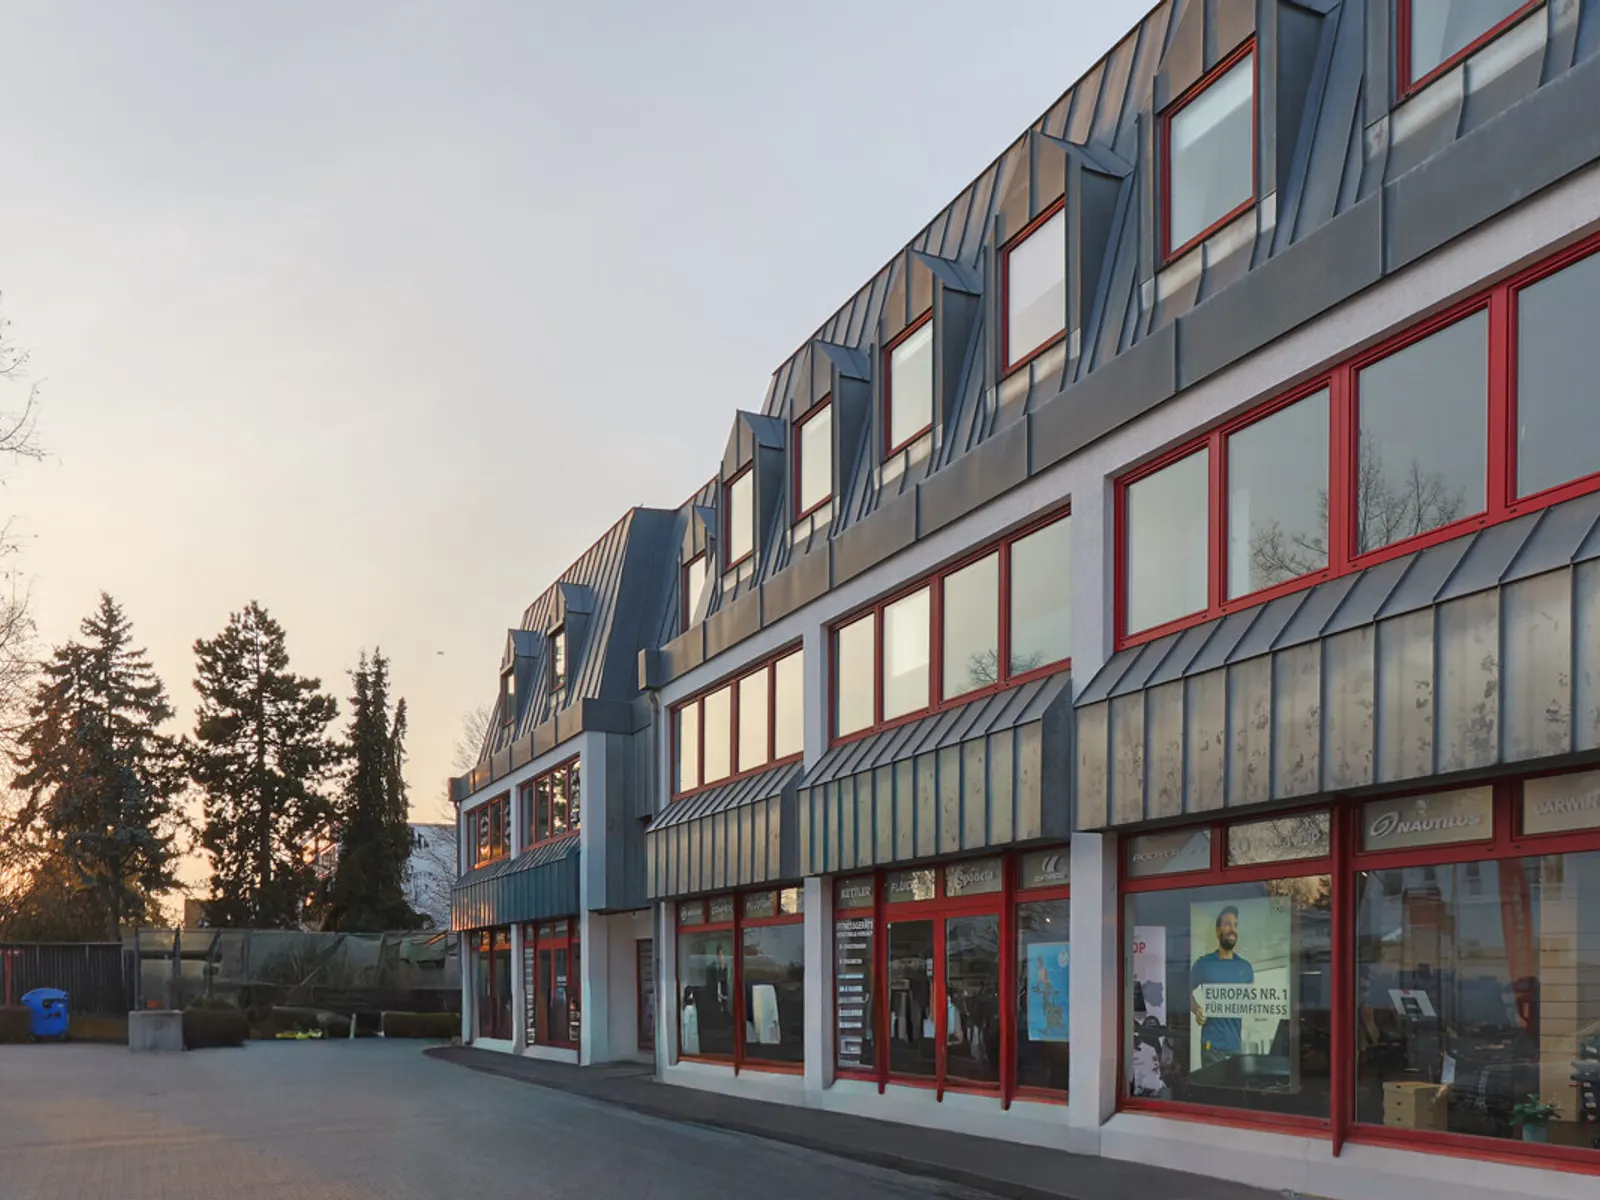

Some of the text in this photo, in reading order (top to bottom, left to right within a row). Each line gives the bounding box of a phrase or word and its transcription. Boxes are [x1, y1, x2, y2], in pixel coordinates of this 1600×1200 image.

[1397, 813, 1481, 834] NAUTILUS
[841, 886, 872, 899] KETTLER
[1205, 987, 1288, 1001] EUROPAS NR. 1
[1204, 1001, 1288, 1016] FÜR HEIMFITNESS
